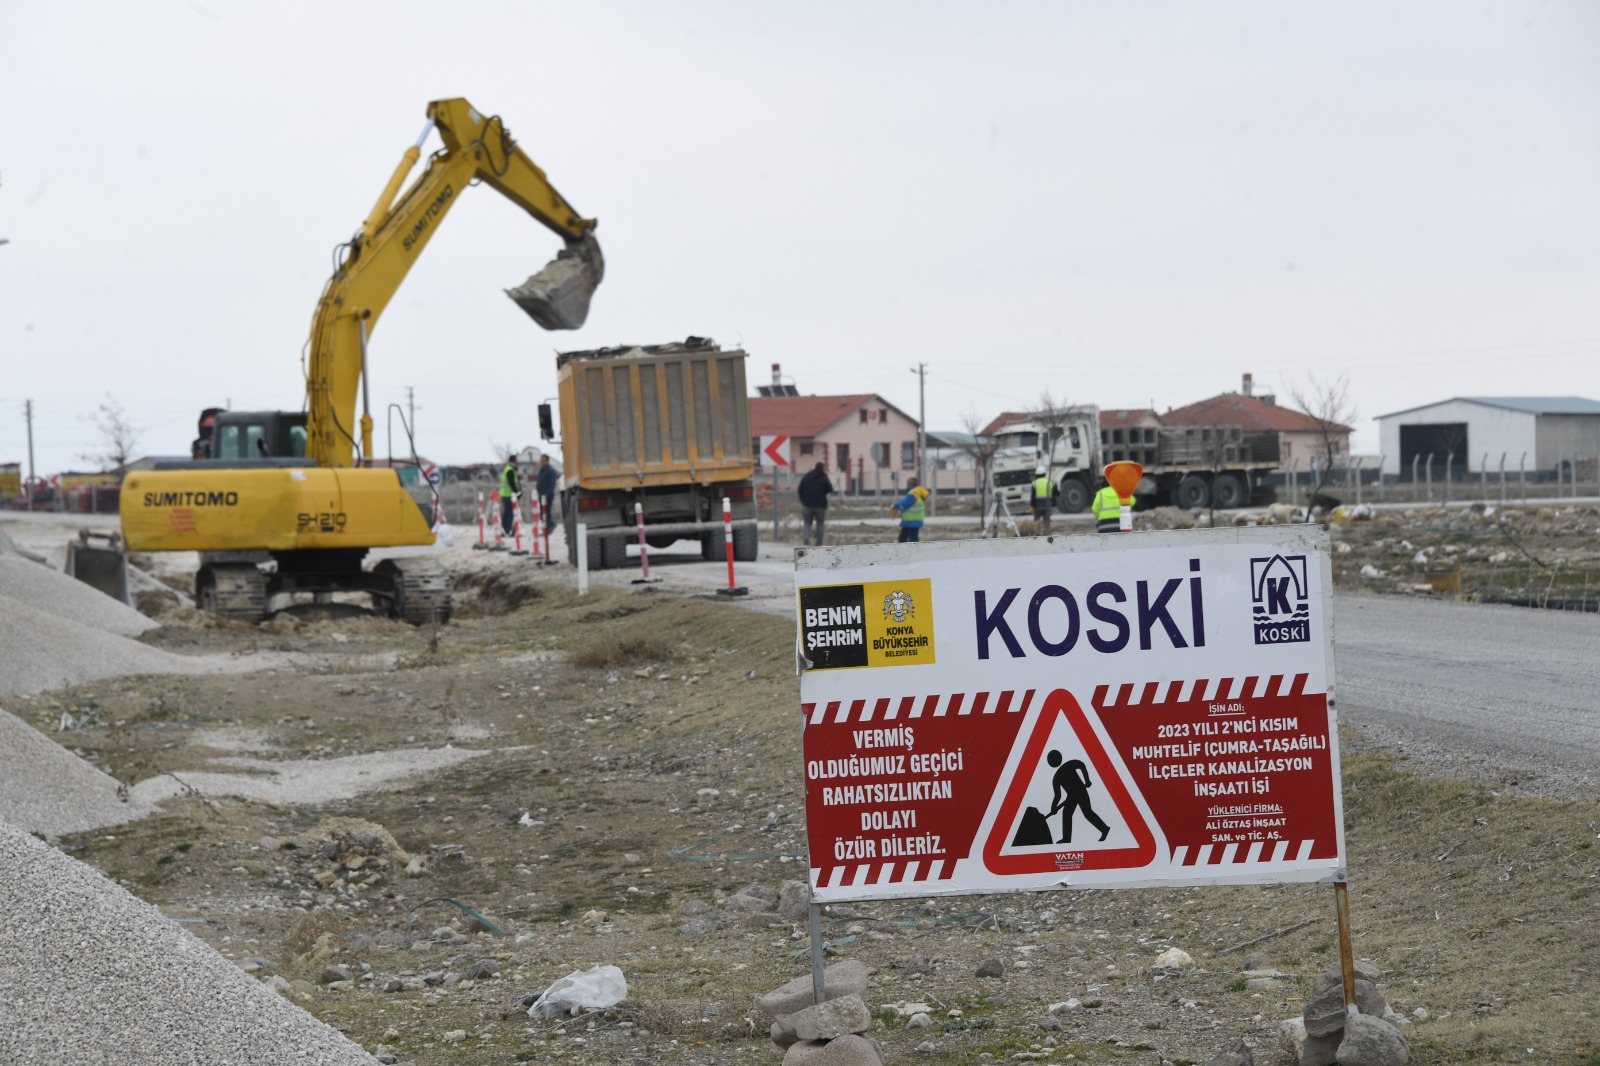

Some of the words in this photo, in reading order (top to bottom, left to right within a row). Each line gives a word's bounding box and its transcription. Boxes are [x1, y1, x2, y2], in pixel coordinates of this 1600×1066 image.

[403, 184, 453, 251] SUMITOMO
[144, 492, 238, 507] SUMITOMO
[1267, 577, 1292, 615] K
[974, 558, 1205, 660] KOSKİ
[873, 634, 928, 650] BÜYÜKŞEHİR
[886, 626, 914, 636] KONYA
[885, 648, 918, 657] BELEDİYESİ
[1209, 703, 1226, 714] İŞİN
[1228, 703, 1245, 712] ADI:
[853, 723, 914, 750] VERMİŞ
[1158, 723, 1190, 738] 2023
[1192, 721, 1219, 736] YILI
[1222, 716, 1257, 734] 2'NCİ
[1259, 717, 1298, 731] KISIM
[1132, 740, 1201, 760] MUHTELİF
[1204, 734, 1326, 757] (ÇUMRA-TAŞAĞIL)
[808, 754, 905, 780] OLDUĞUMUZ
[910, 747, 963, 777] GEÇİCİ
[1148, 761, 1205, 779] İLÇELER
[1208, 757, 1312, 776] KANALİZASYON
[823, 780, 952, 806] RAHATSIZLIKTAN
[1194, 780, 1249, 798] İNŞAATI
[1251, 776, 1270, 796] İŞİ
[861, 809, 917, 831] DOLAYI
[1208, 804, 1252, 815] YÜKLENİCİ
[1254, 803, 1283, 812] FİRMA:
[1206, 820, 1220, 830] ALİ
[1222, 819, 1251, 829] ÖZTAŞ
[1253, 817, 1287, 828] İNŞAAT
[834, 836, 876, 860] ÖZÜR
[881, 831, 946, 857] DİLERİZ.
[1212, 833, 1234, 842] SAN.
[1248, 830, 1265, 840] TİC.
[1267, 831, 1282, 840] AŞ.
[1055, 852, 1084, 860] VATAN
